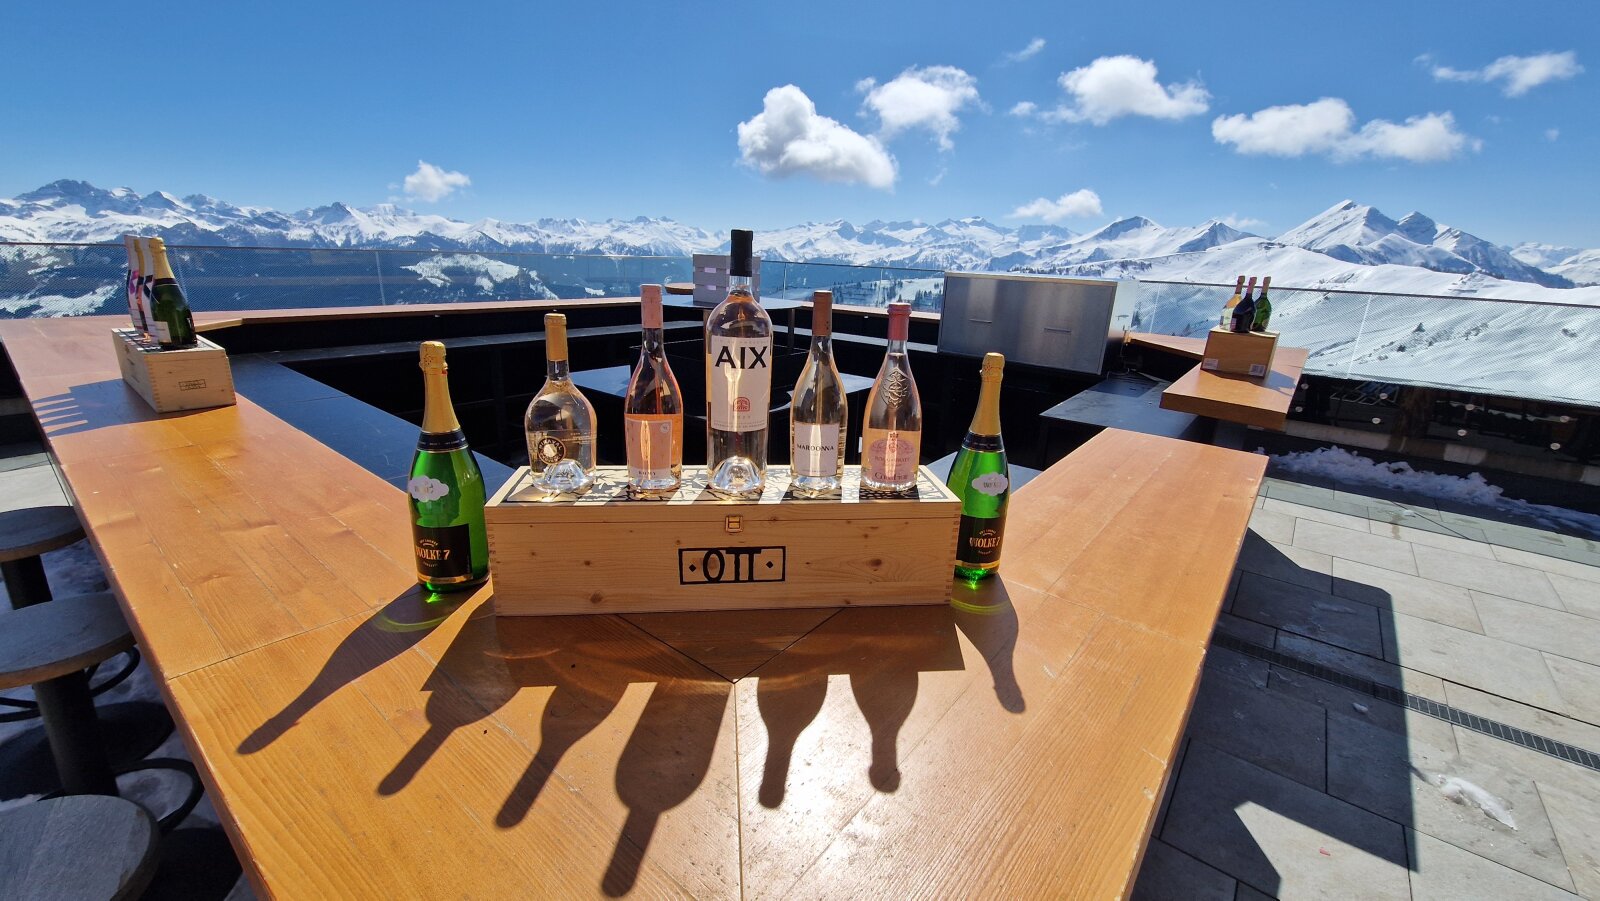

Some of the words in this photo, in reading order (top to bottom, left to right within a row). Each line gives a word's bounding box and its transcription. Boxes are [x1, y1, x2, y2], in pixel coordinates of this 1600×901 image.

[715, 346, 768, 369] AIX
[415, 546, 441, 560] WOLKE
[443, 549, 450, 560] 7
[703, 547, 762, 582] OTT
